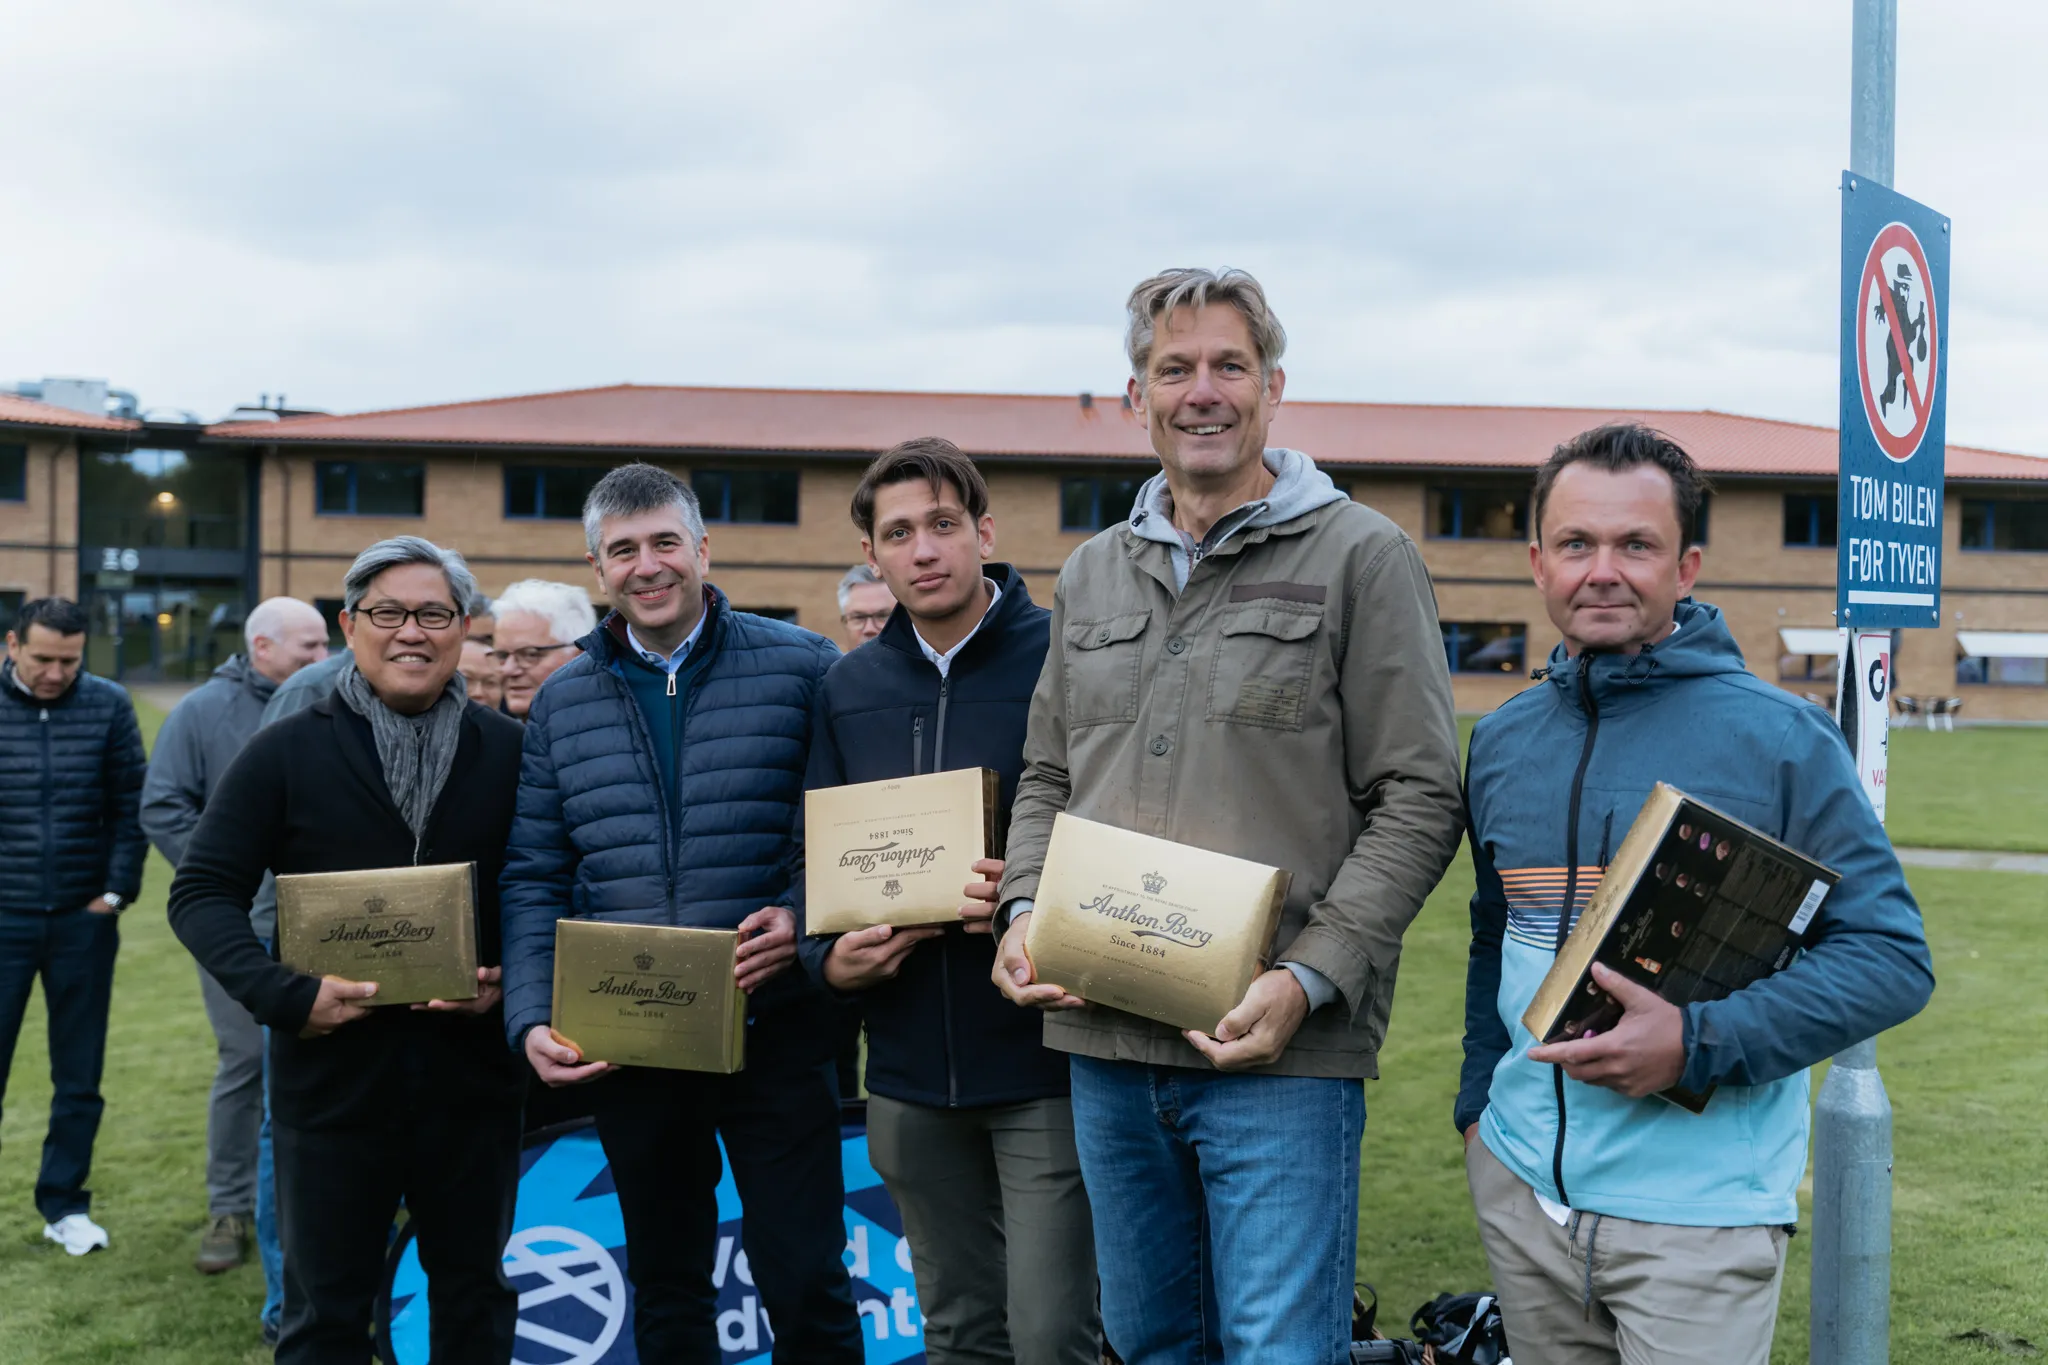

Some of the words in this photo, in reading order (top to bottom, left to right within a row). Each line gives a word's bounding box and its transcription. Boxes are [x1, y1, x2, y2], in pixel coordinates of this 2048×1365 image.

[1850, 475, 1888, 521] TØM
[1892, 482, 1936, 527] BILEN
[1848, 538, 1884, 582] FØR
[1888, 542, 1935, 585] TYVEN
[869, 830, 889, 840] 1884
[893, 827, 914, 836] Since
[838, 848, 877, 874] Berg
[880, 845, 945, 868] Anthon
[320, 922, 390, 943] Anthon
[387, 919, 436, 944] Berg
[1079, 893, 1159, 929] Anthon
[1159, 912, 1213, 948] Berg
[1109, 935, 1136, 950] Since
[1139, 943, 1166, 958] 1884
[589, 976, 655, 999] Anthon
[654, 980, 698, 1006] Berg
